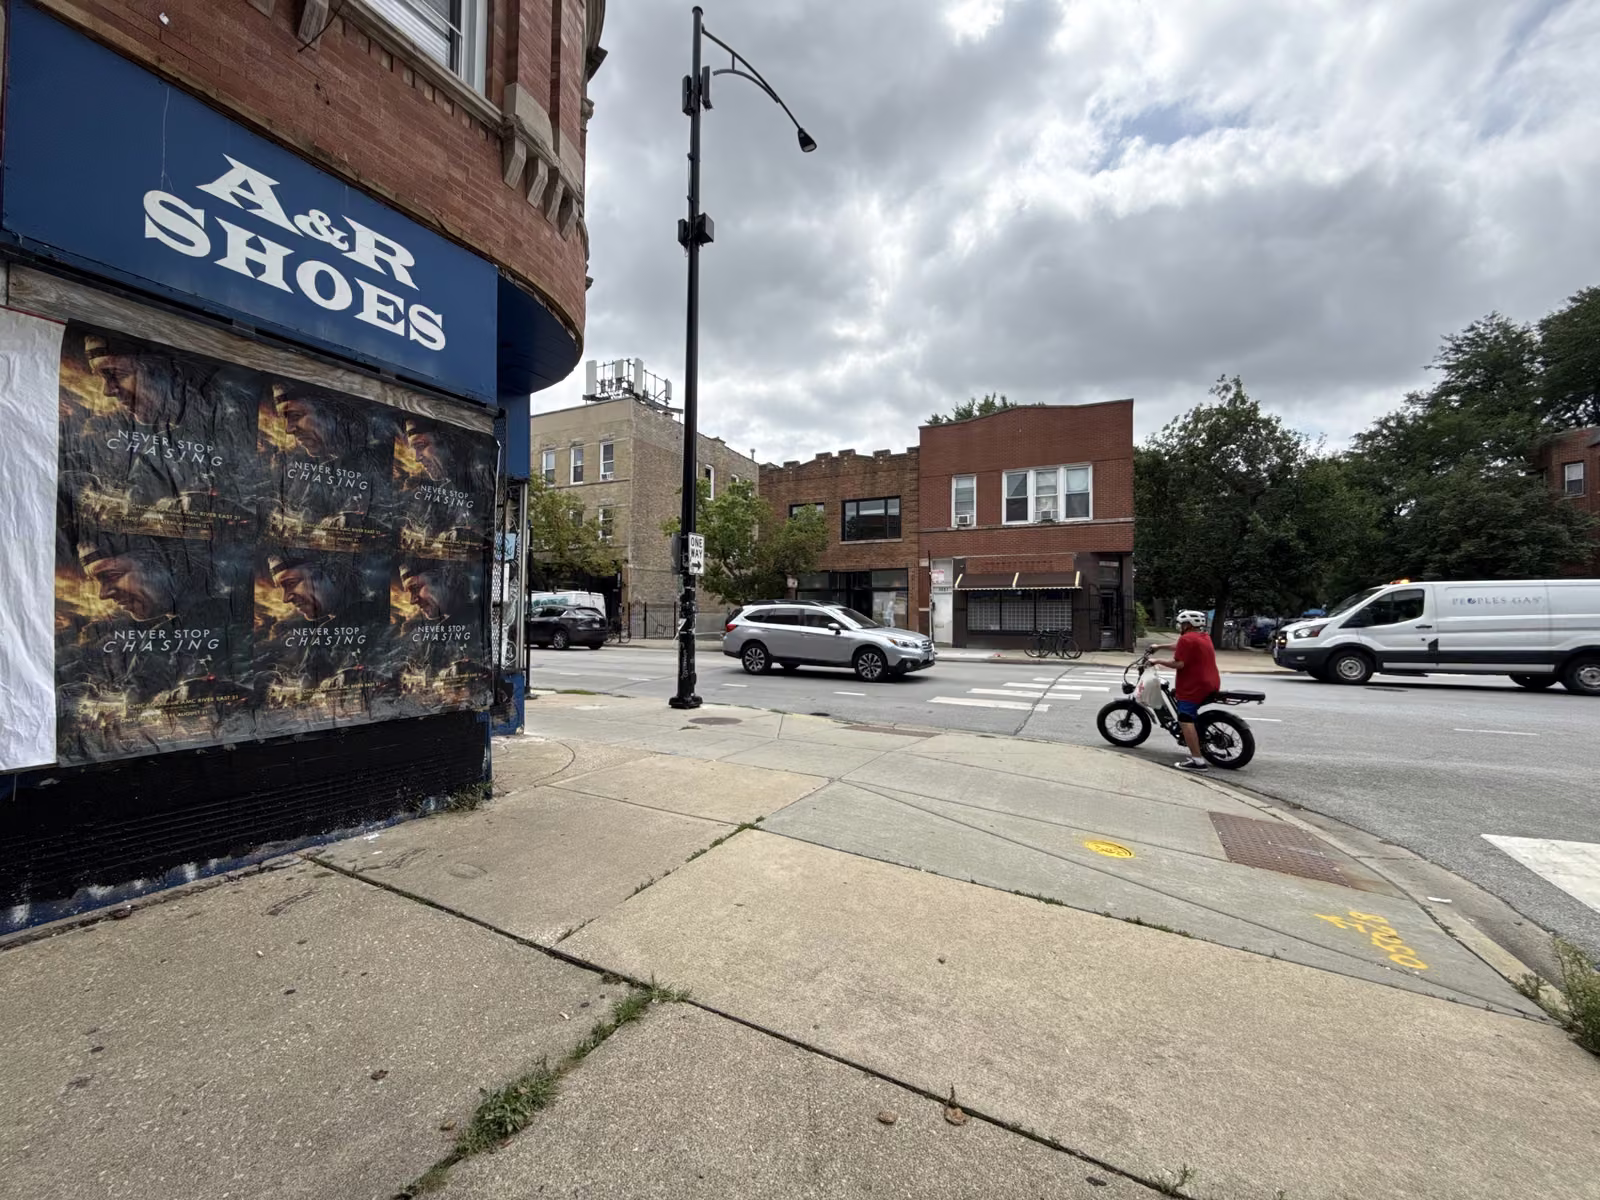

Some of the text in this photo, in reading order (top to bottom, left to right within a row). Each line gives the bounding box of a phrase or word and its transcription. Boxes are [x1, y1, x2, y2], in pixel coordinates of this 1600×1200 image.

[196, 153, 419, 291] A&R
[143, 190, 446, 351] SHOES
[118, 429, 214, 454] NEVER STOP
[107, 438, 223, 466] CHASING
[295, 461, 362, 479] NEVER STOP
[287, 469, 368, 490] CHASING
[420, 484, 469, 499] NEVER STOP
[414, 491, 474, 509] CHASING
[691, 537, 702, 548] ONE
[691, 549, 702, 559] WAY
[115, 629, 211, 640] NEVER STOP
[293, 627, 360, 636] NEVER STOP
[418, 625, 445, 633] NEVER
[285, 635, 366, 647] CHASING
[412, 632, 471, 642] CHASING
[103, 638, 220, 653] CHASING
